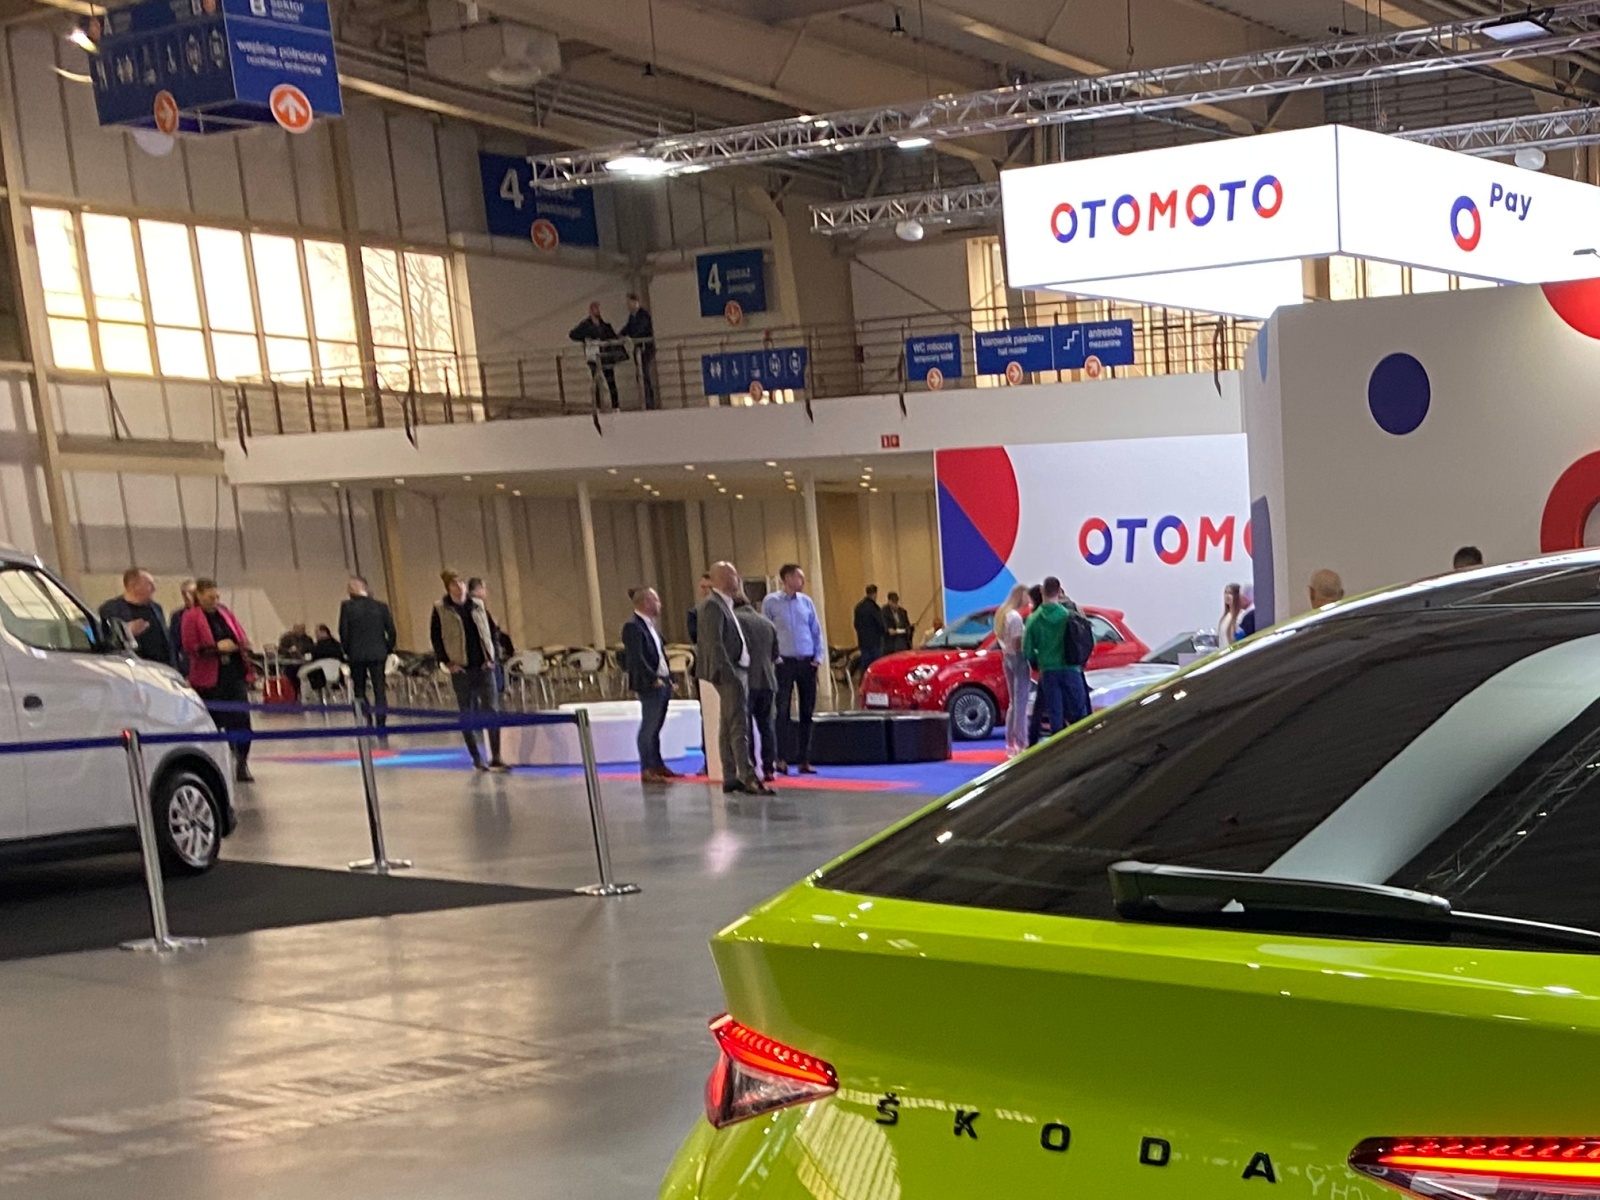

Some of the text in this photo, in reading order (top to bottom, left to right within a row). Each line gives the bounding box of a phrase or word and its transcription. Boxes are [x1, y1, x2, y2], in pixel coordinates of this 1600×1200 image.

[500, 168, 524, 210] 4
[1050, 174, 1283, 244] OTOMOTO
[1489, 182, 1532, 221] Pay
[707, 263, 722, 296] 4
[912, 341, 926, 354] WC
[1088, 326, 1123, 338] antresola
[1078, 515, 1253, 566] OTOM
[875, 1092, 1277, 1184] ŠKODA
